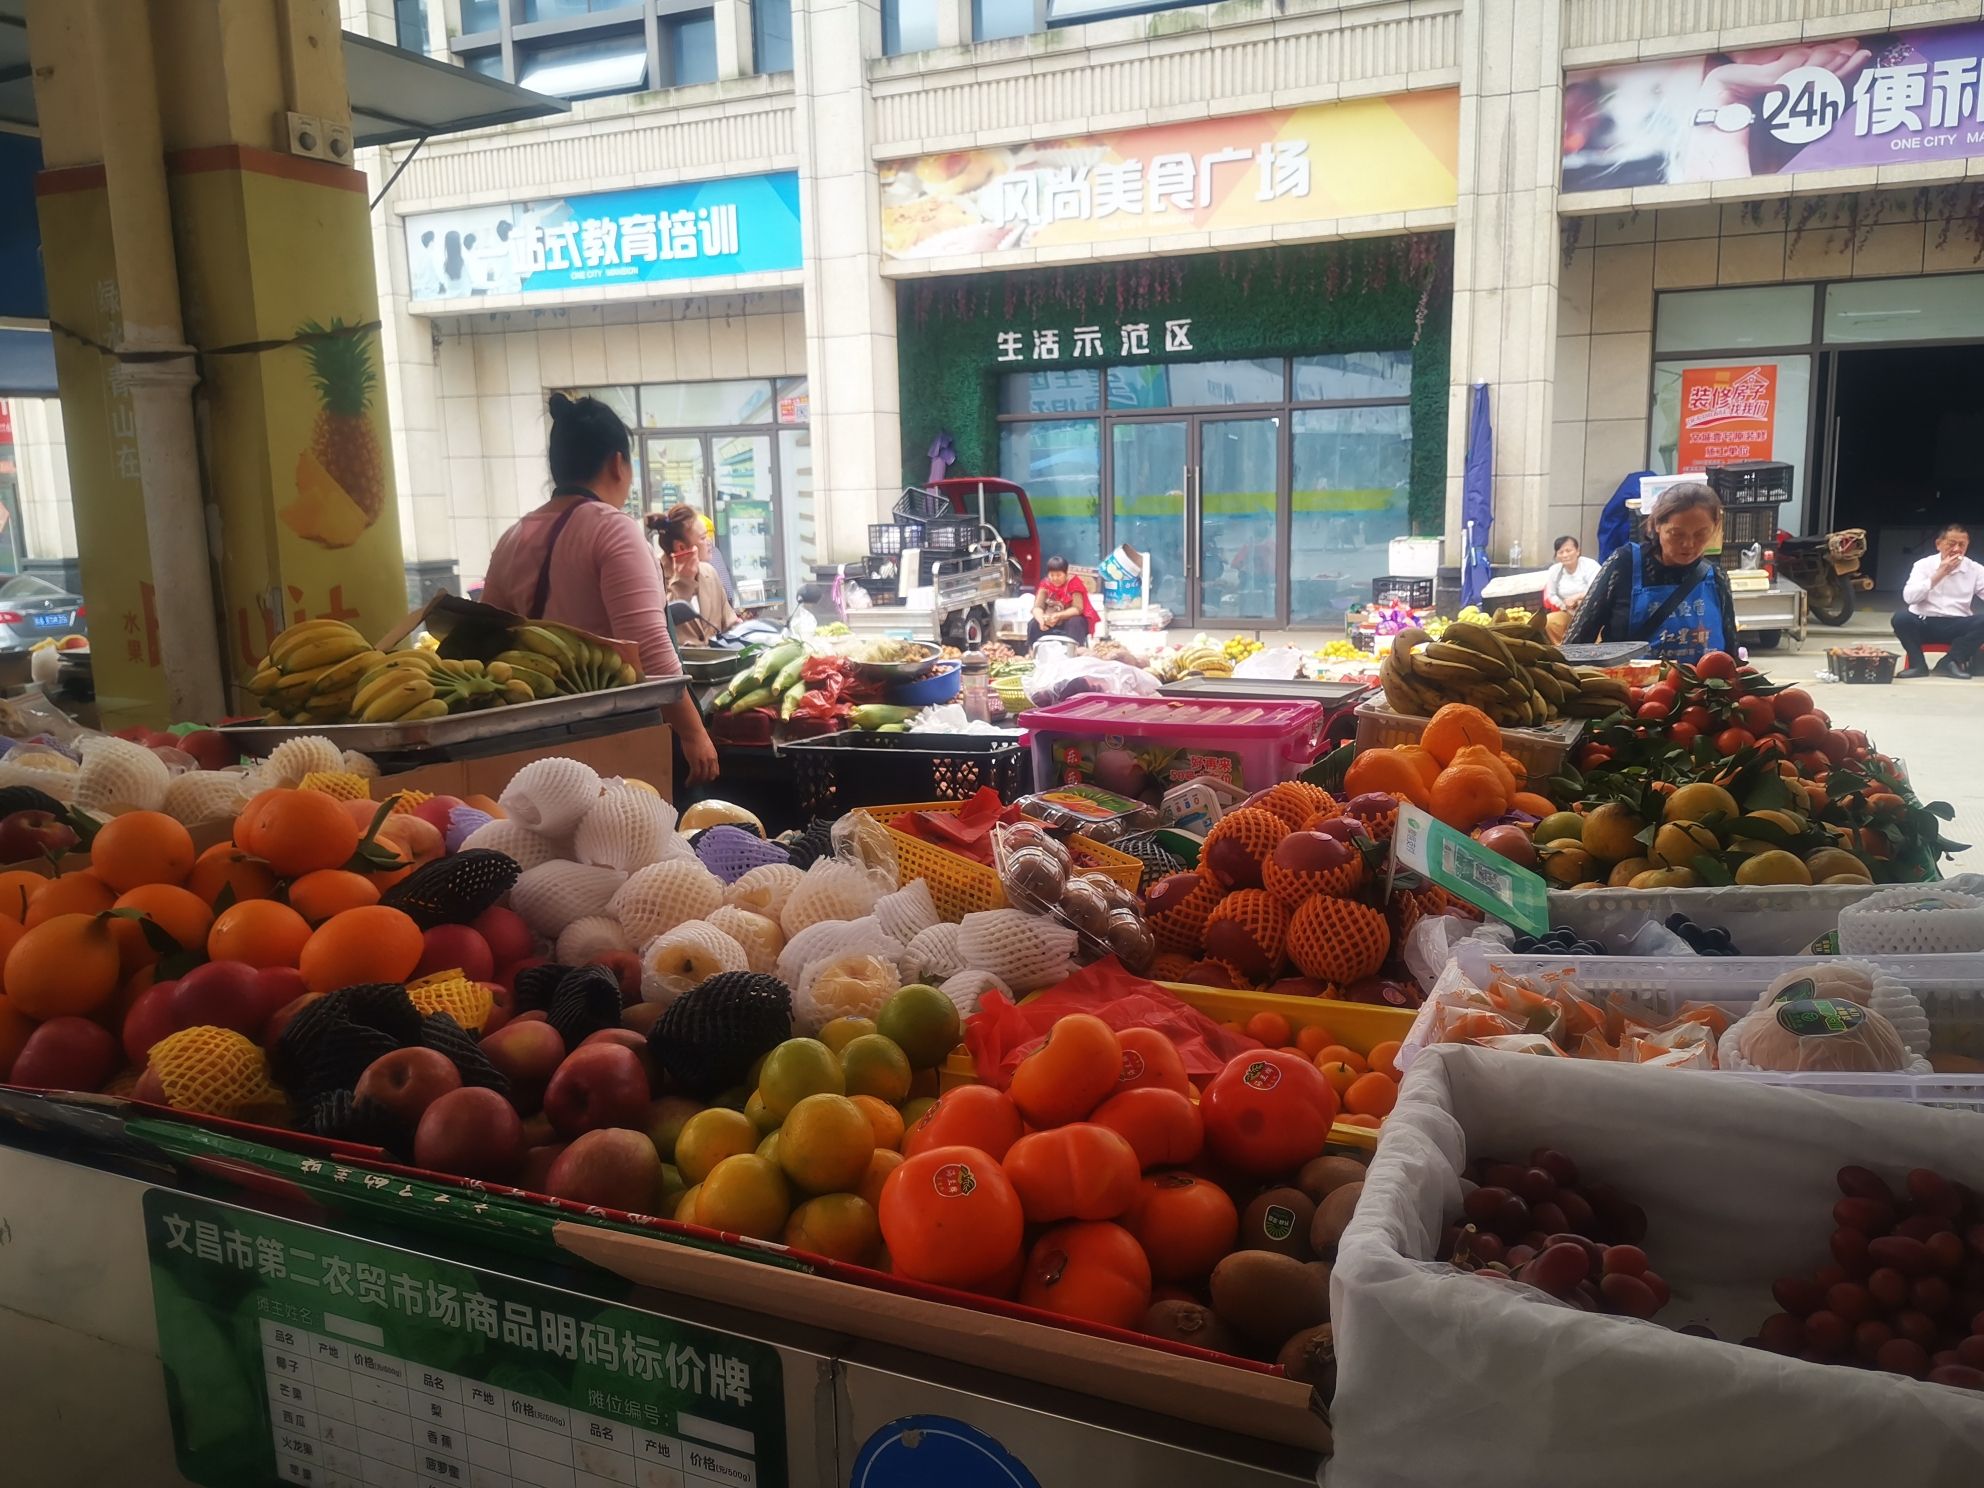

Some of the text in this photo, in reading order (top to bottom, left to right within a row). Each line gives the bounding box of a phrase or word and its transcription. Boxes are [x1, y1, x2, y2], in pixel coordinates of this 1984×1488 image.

[1890, 137, 1921, 150] ONE
[1923, 134, 1957, 148] CITY
[995, 139, 1311, 229] 风尚美食广场
[995, 317, 1194, 364] 生活示范区
[122, 609, 144, 664] 水果
[1189, 754, 1233, 773] 好再来
[161, 1211, 754, 1409] 文昌市第二农贸市场商品明码标价牌
[274, 1329, 295, 1346] 品名
[317, 1341, 339, 1359] 产地
[423, 1373, 446, 1391] 品名
[471, 1386, 495, 1407] 产地
[282, 1409, 306, 1428] 西瓜
[427, 1429, 453, 1451] 香蕉
[589, 1422, 615, 1443] 品名
[281, 1435, 314, 1457] 火龙果
[644, 1438, 671, 1459] 产地
